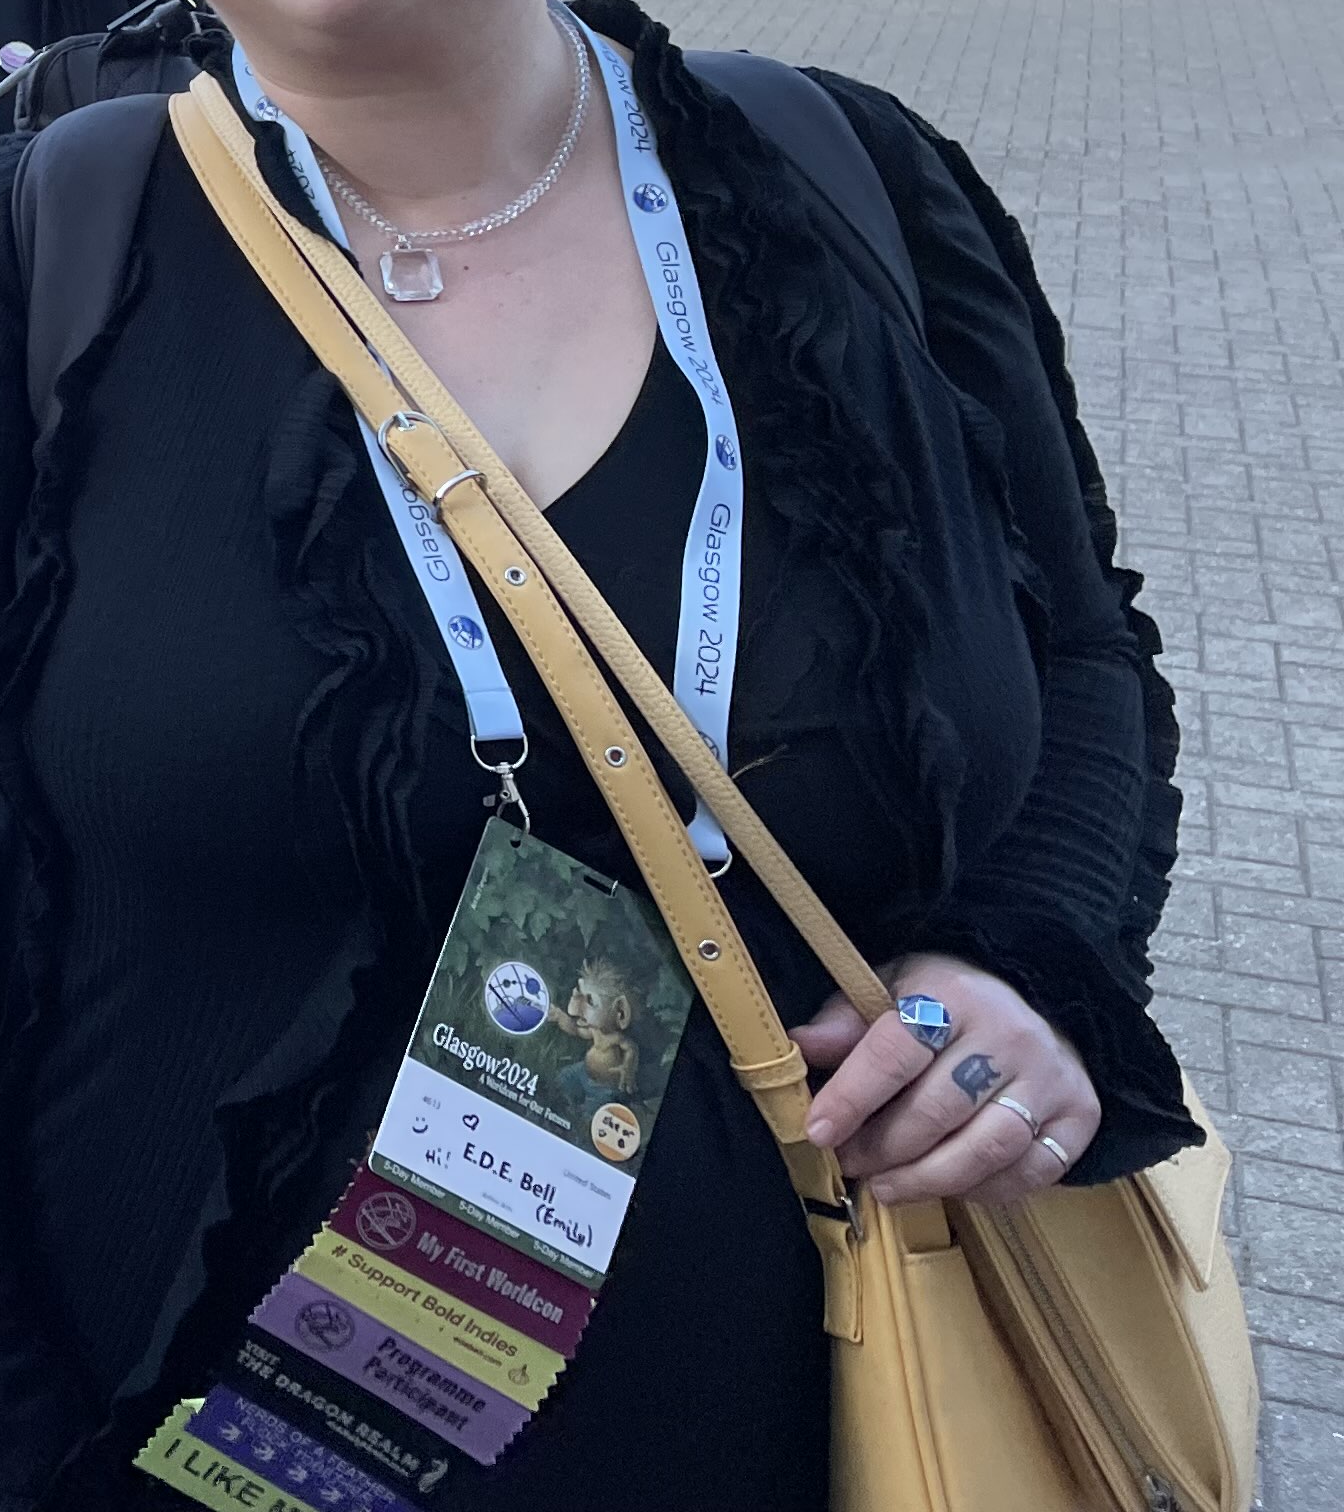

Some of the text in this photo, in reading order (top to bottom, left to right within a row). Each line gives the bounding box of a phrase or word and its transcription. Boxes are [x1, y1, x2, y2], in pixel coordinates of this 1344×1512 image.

[623, 102, 650, 153] 2024
[656, 242, 725, 406] Glasgow 2024
[400, 483, 450, 582] Glasgo
[694, 504, 731, 697] Glasgow 2024
[433, 1023, 539, 1096] Glasgow2024
[384, 1162, 445, 1199] 5-Day Member
[425, 1148, 451, 1169] Hi!
[463, 1143, 556, 1204] E.D.E. Bell
[459, 1201, 520, 1239] 5-Day Member
[417, 1231, 564, 1324] My First Worldcon
[533, 1240, 594, 1278] 5-Day Member
[332, 1244, 346, 1257] #
[348, 1253, 421, 1303] Support
[421, 1294, 464, 1326] Bold
[464, 1317, 518, 1358] Indies
[237, 1349, 274, 1379] THE
[276, 1374, 354, 1426] DRAGON
[354, 1423, 419, 1471] REALM
[363, 1355, 468, 1431] Participant
[378, 1335, 486, 1413] Programme
[234, 1396, 286, 1433] NERDS
[164, 1438, 264, 1508] I LIKE
